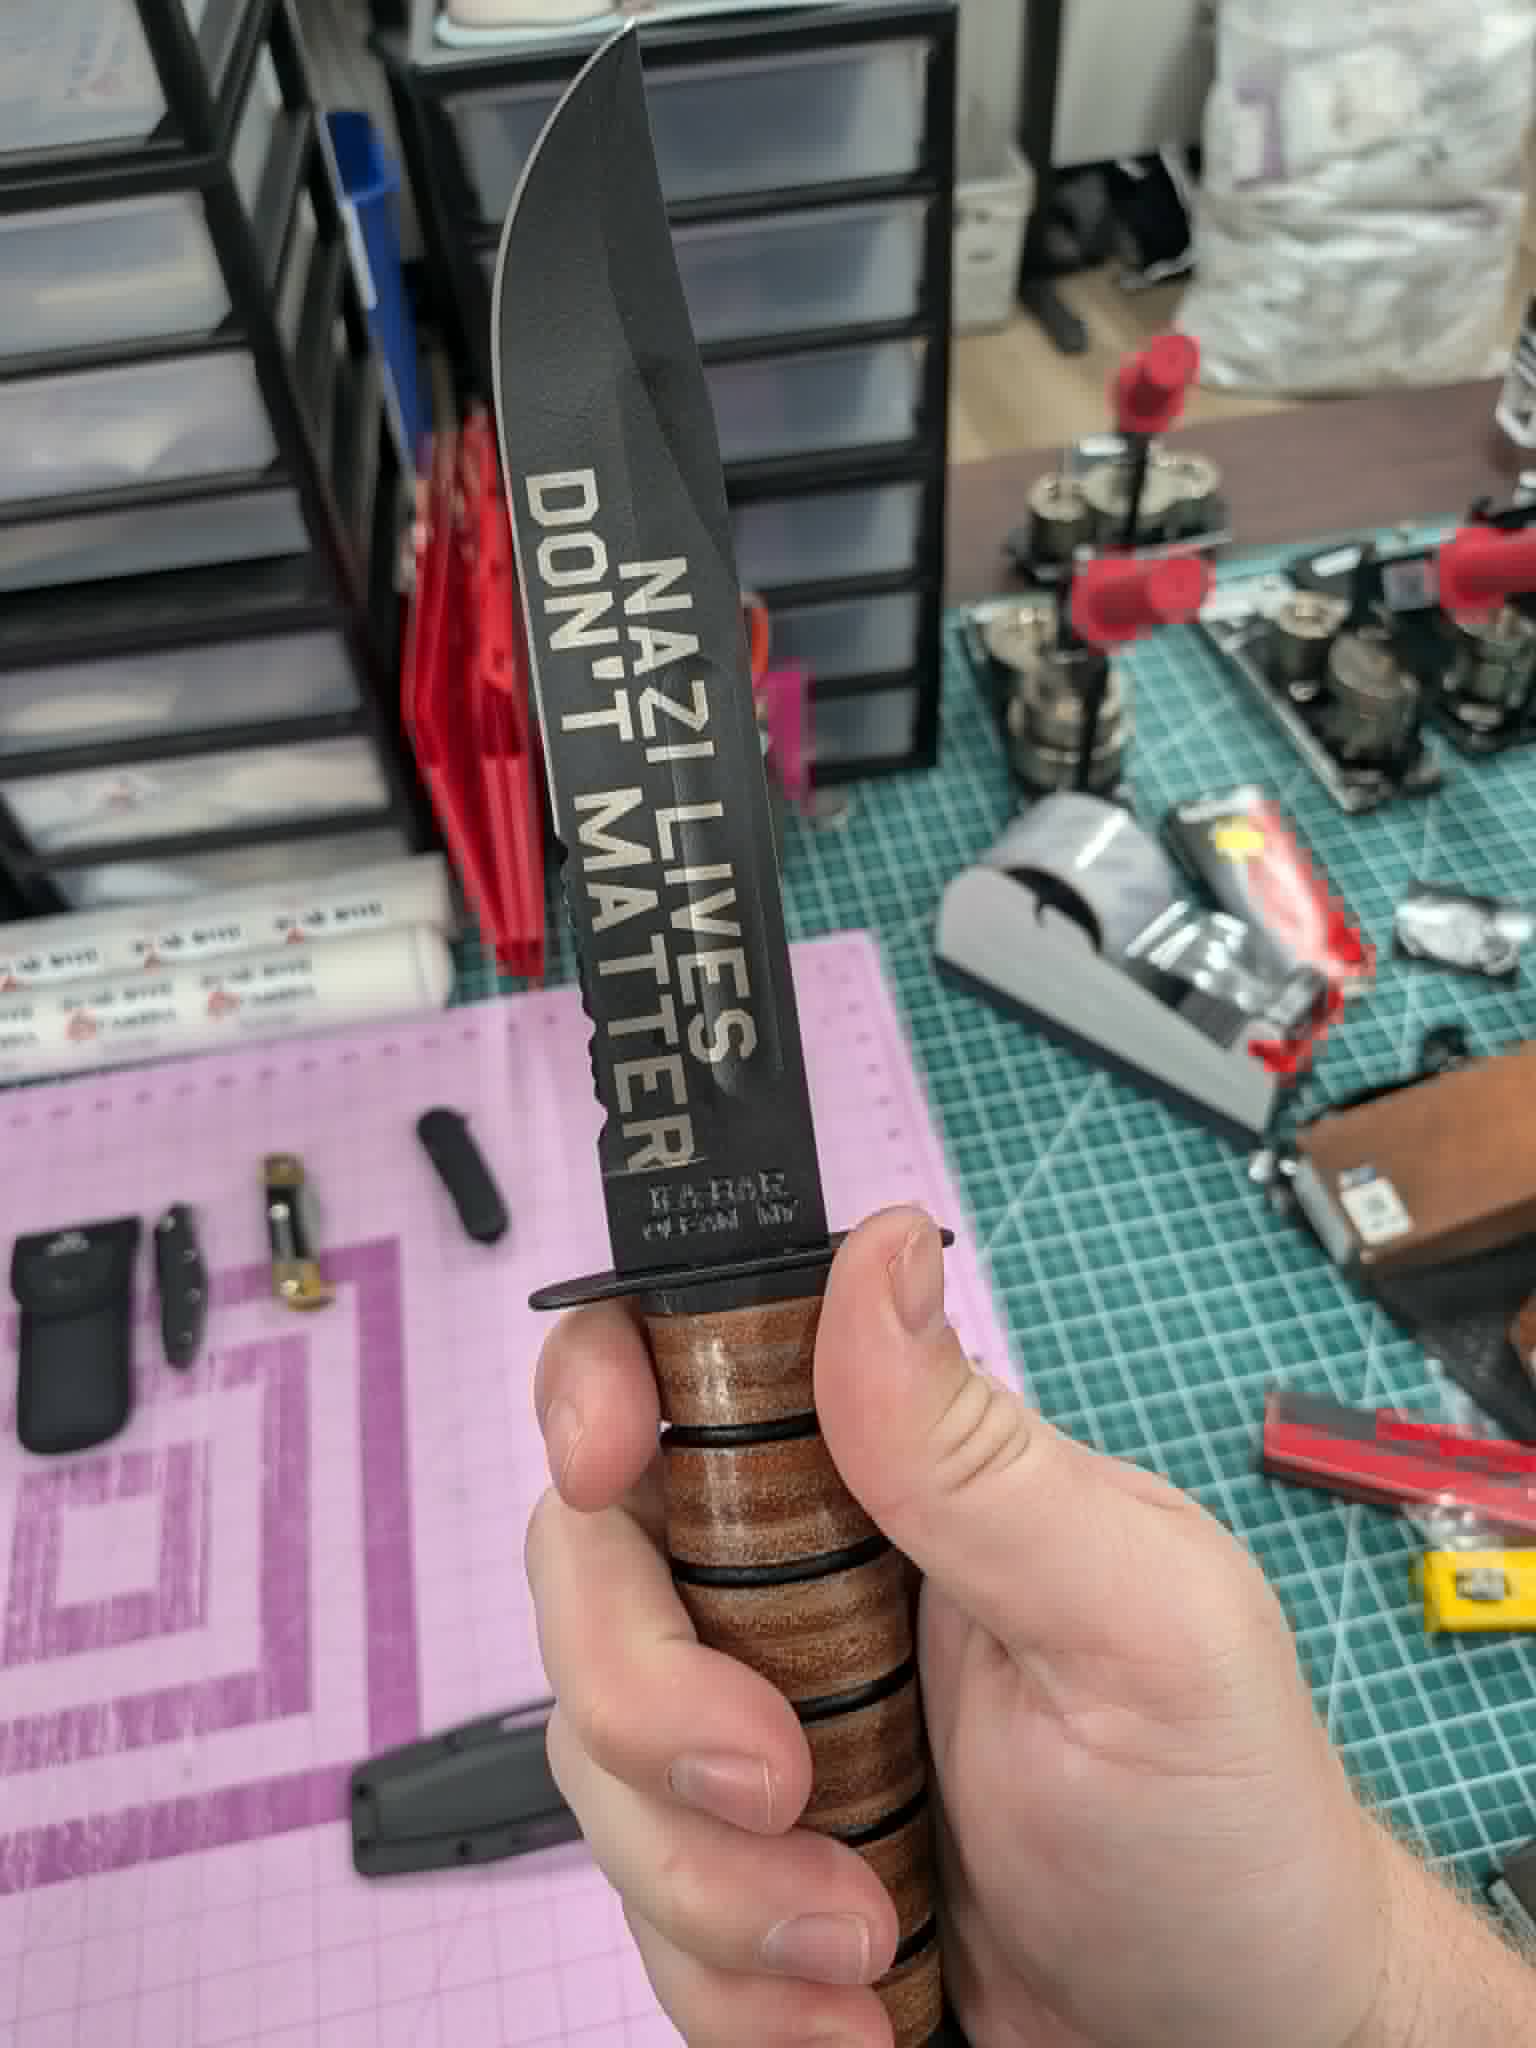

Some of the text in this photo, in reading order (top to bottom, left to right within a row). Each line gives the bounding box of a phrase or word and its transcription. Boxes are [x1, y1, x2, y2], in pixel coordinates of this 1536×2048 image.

[525, 467, 696, 1171] DON'T MATTER
[618, 556, 758, 1064] NAZI LIVES
